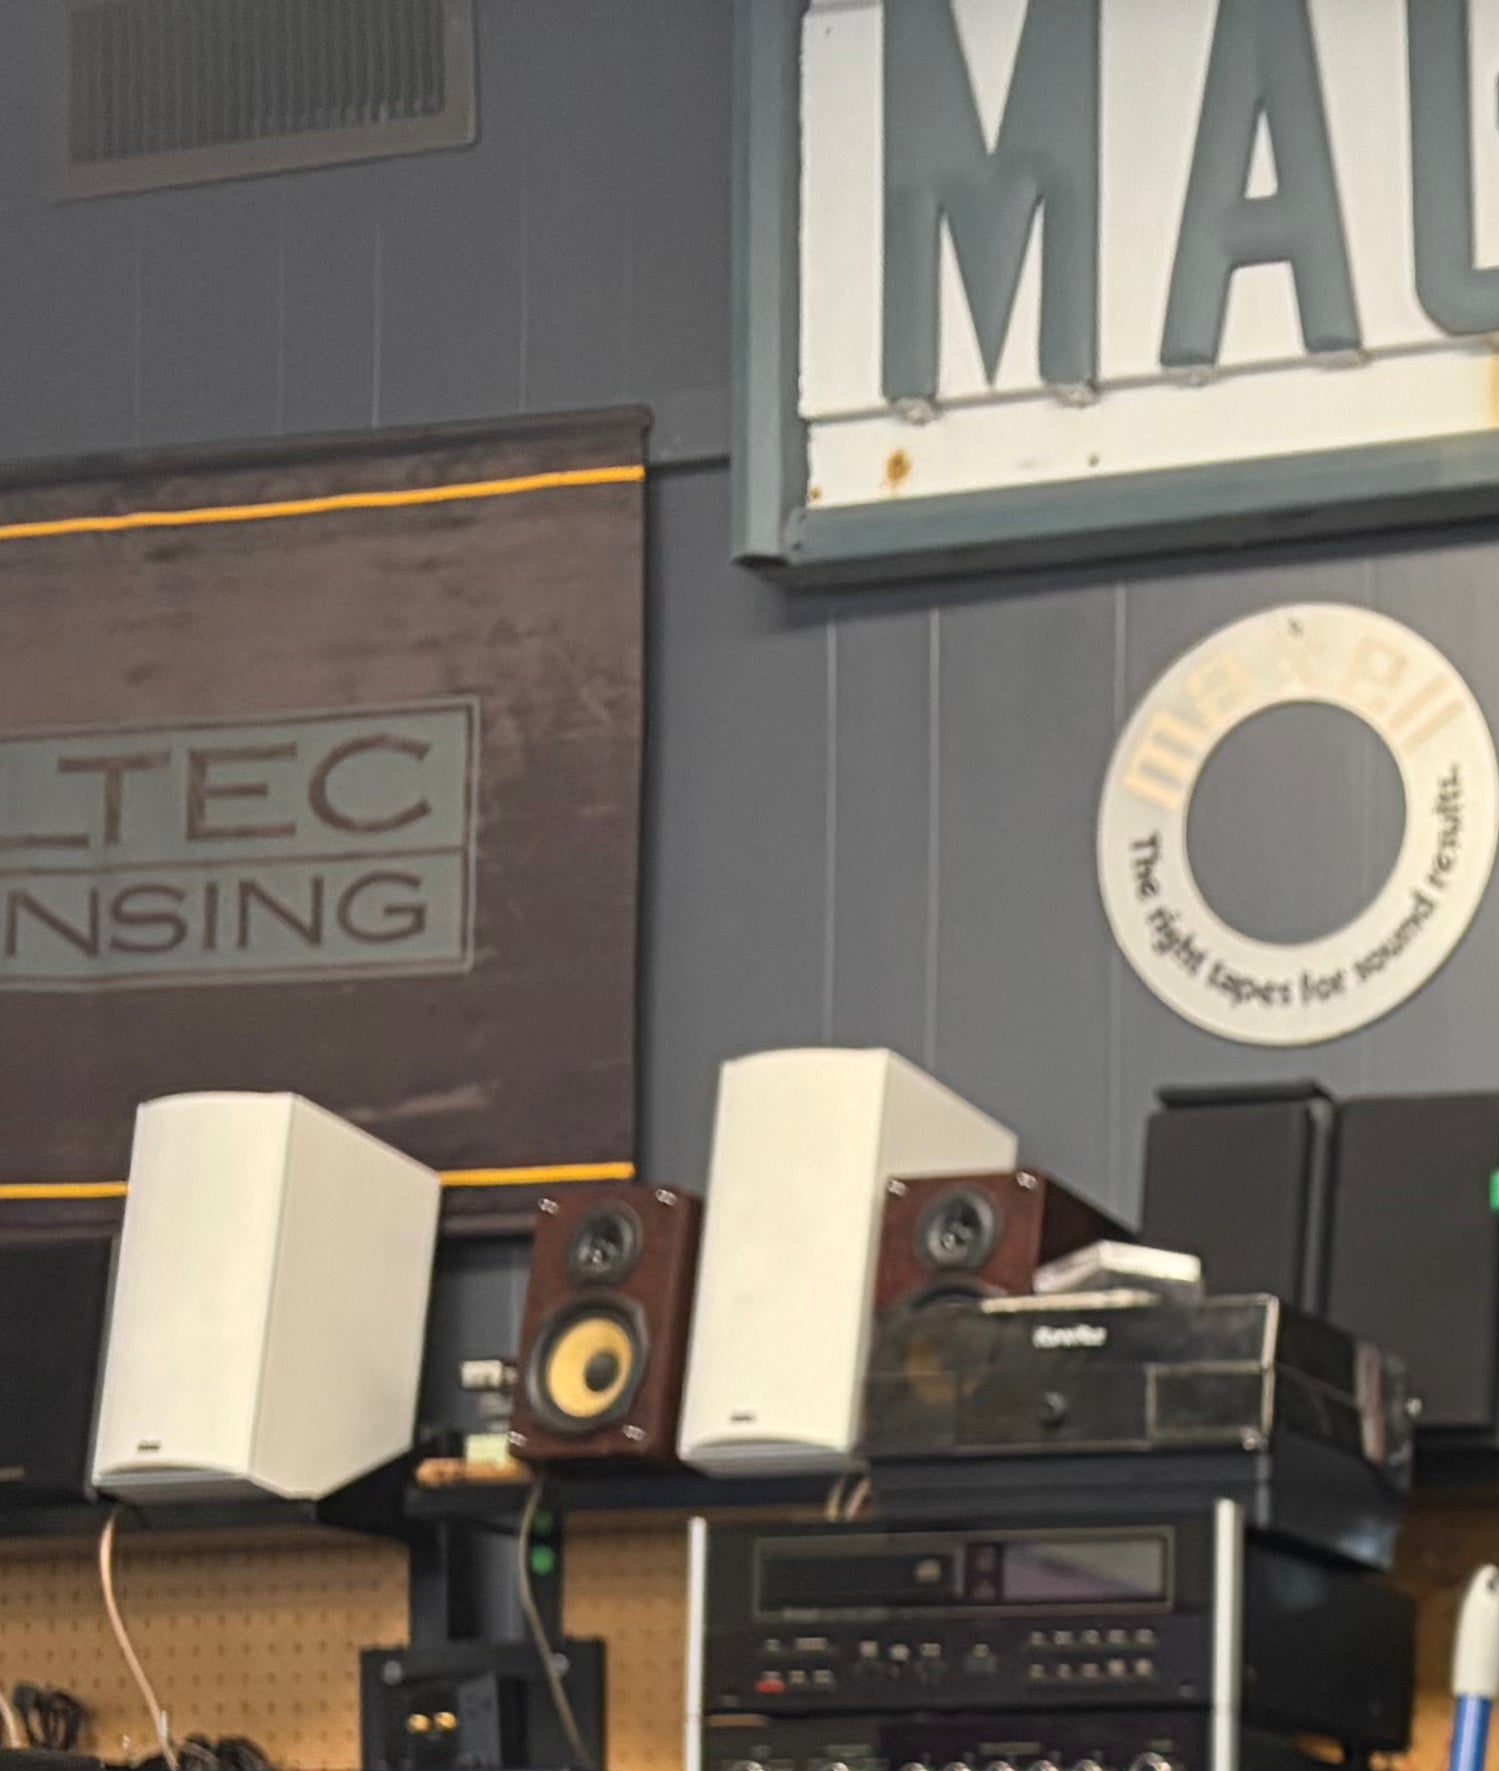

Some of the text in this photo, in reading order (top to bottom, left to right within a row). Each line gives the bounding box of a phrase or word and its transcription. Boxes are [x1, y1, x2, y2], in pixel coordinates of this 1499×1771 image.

[3, 870, 428, 960] NSING
[1130, 832, 1161, 899] The
[1147, 905, 1206, 977] right
[1205, 961, 1292, 1006] tapes
[1301, 969, 1343, 1006] for
[1353, 886, 1436, 982] sound
